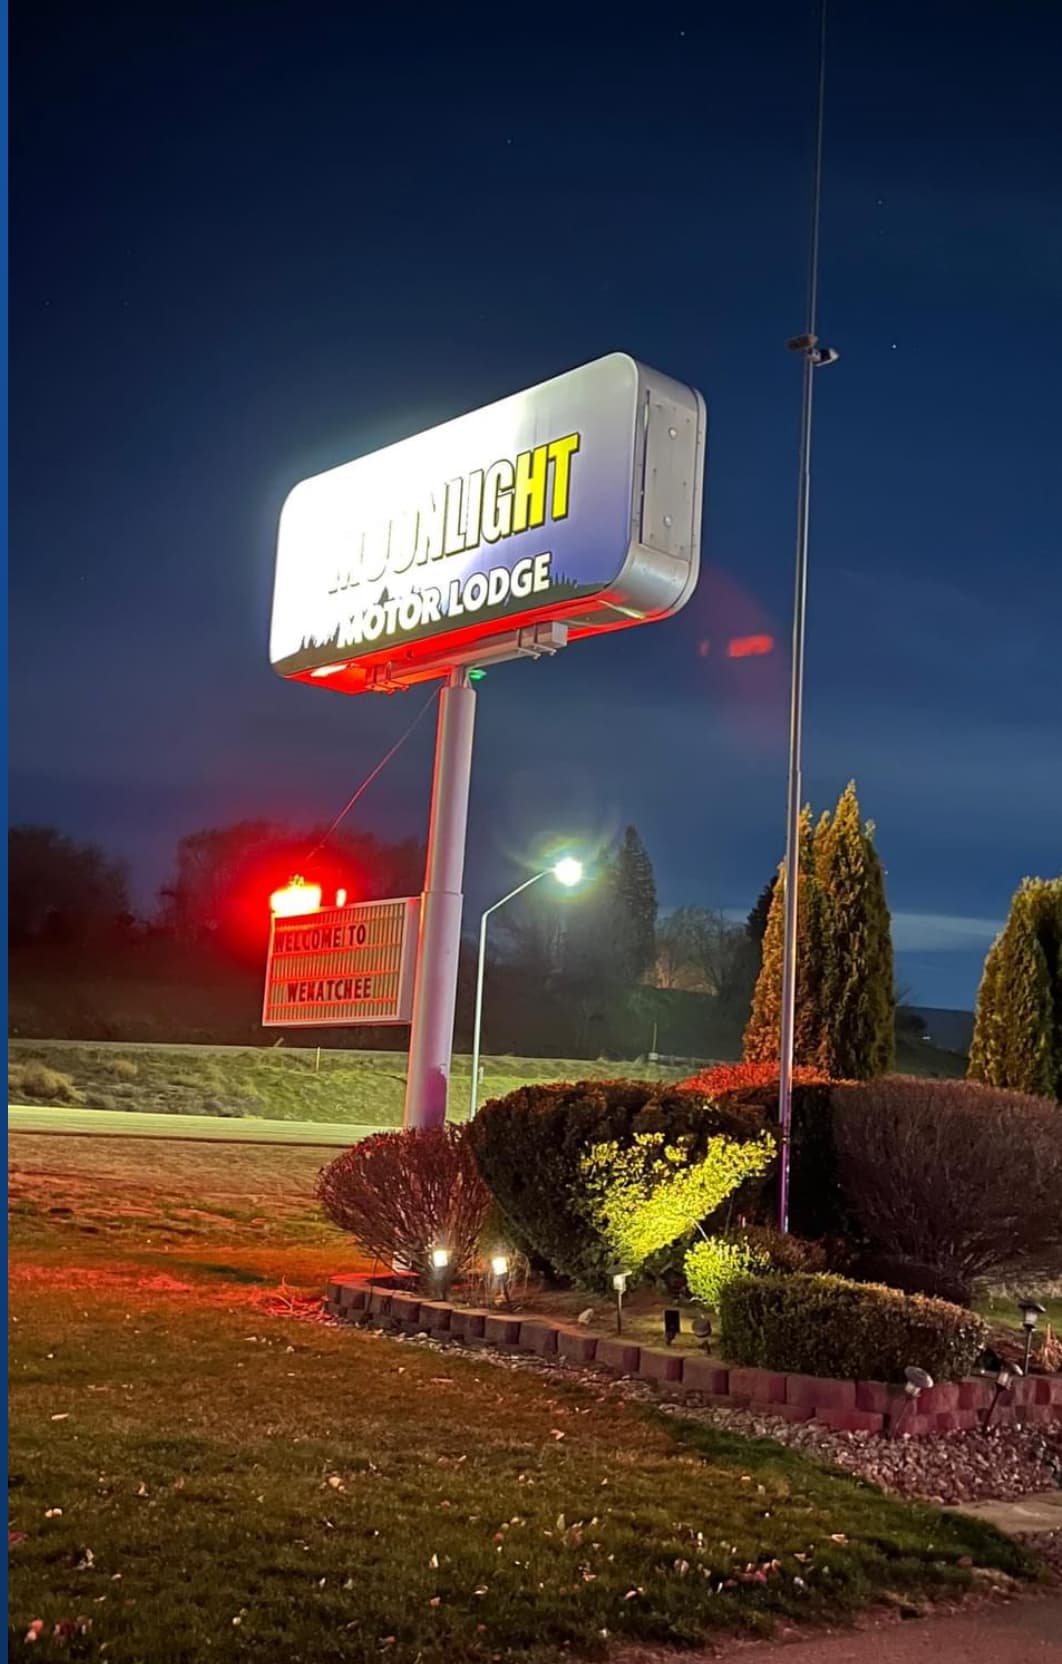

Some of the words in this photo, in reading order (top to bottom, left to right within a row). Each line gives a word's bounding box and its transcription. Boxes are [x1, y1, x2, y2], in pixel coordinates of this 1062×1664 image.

[334, 588, 441, 649] MOTOR
[449, 551, 552, 618] LODGE
[275, 928, 341, 952] WELCOME
[348, 924, 366, 946] TO
